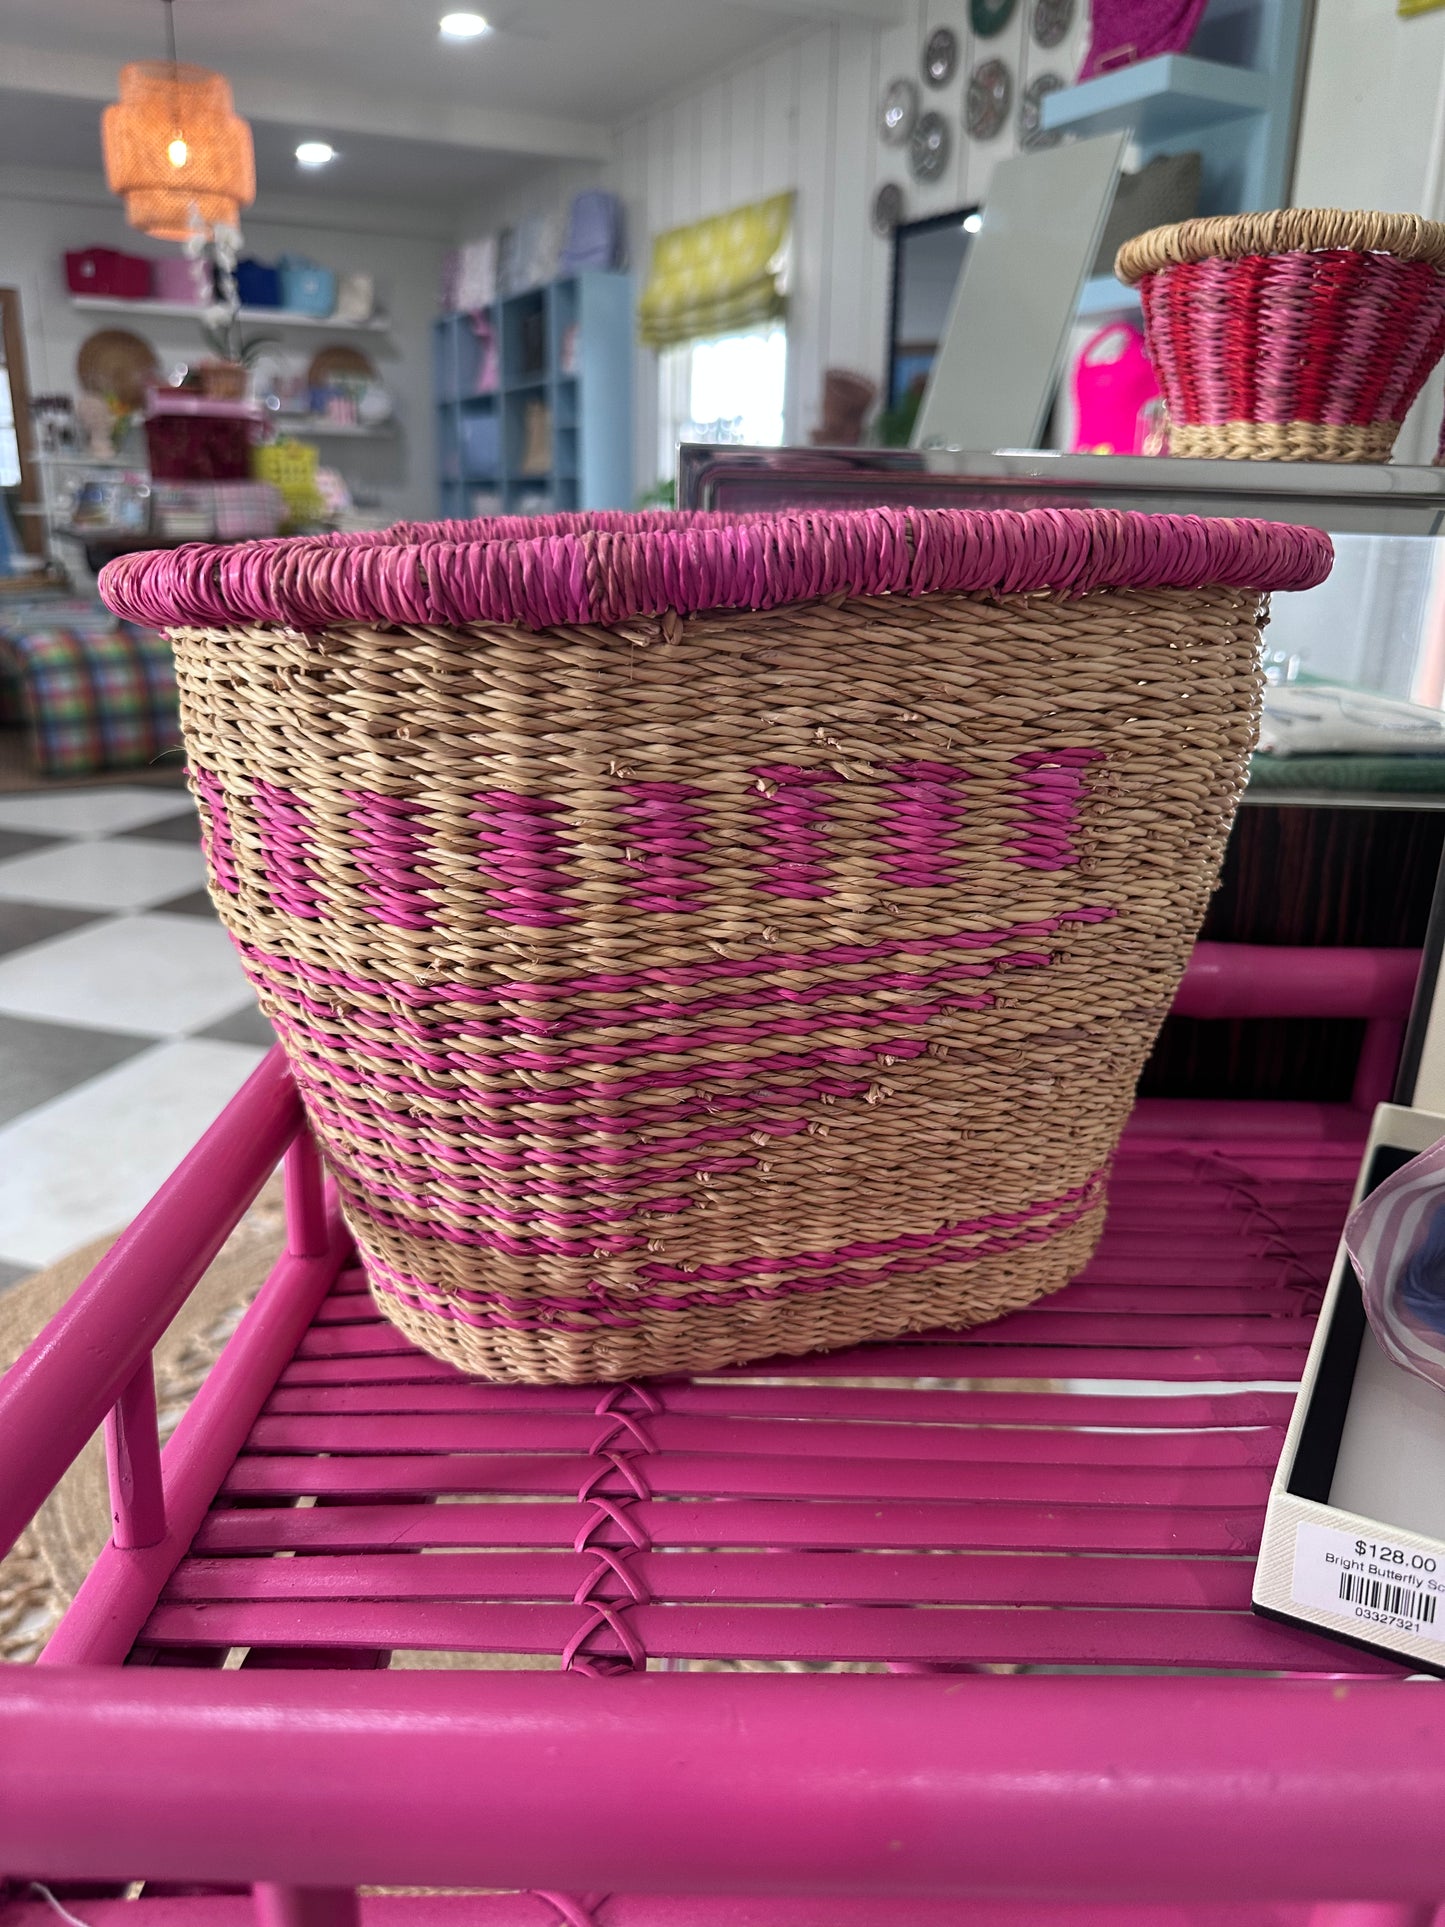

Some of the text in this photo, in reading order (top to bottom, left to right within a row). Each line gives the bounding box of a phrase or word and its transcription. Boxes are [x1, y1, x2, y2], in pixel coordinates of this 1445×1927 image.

[1325, 1552, 1364, 1571] Bright
[1368, 1563, 1424, 1589] Butterfly
[1354, 1540, 1437, 1572] $128.00
[1355, 1607, 1420, 1632] 03327321
